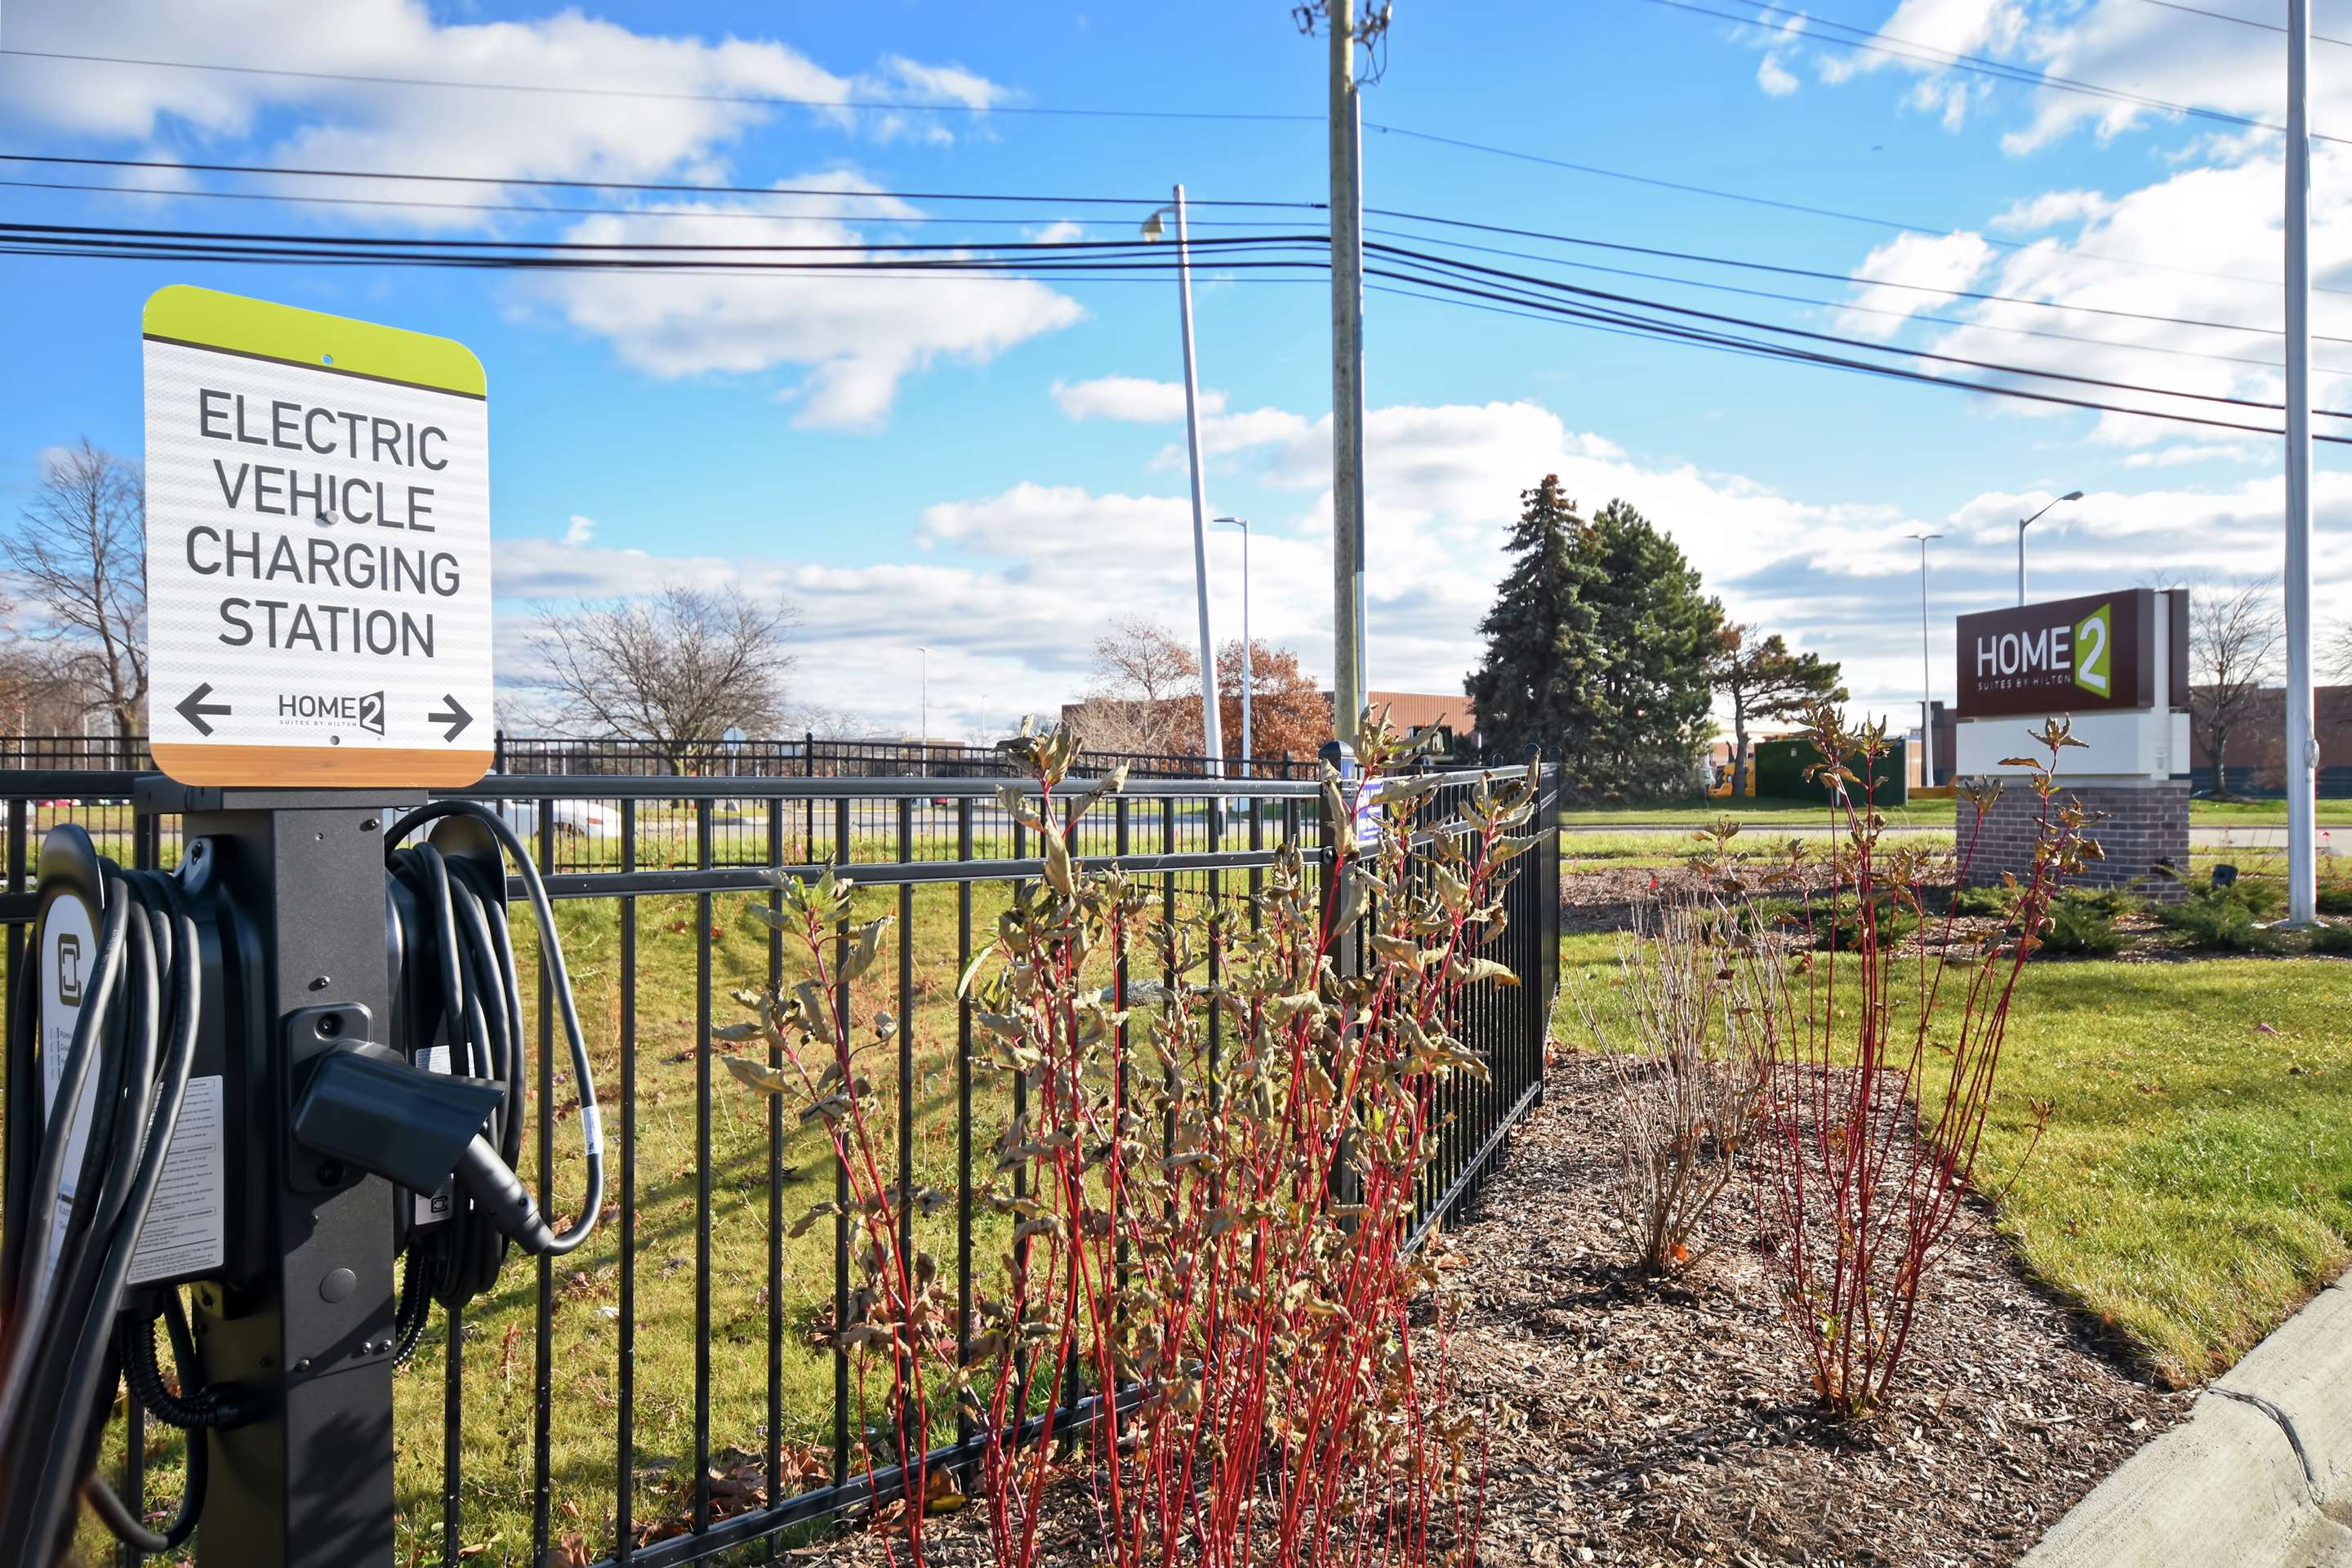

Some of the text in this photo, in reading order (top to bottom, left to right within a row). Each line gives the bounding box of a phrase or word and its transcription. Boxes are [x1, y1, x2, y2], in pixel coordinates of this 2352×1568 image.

[199, 388, 449, 471] ELECTRIC
[213, 458, 435, 533] VEHICLE
[185, 525, 460, 597] CHARGING
[217, 597, 434, 658] STATION
[1977, 674, 2071, 692] SUITES BY HILTON
